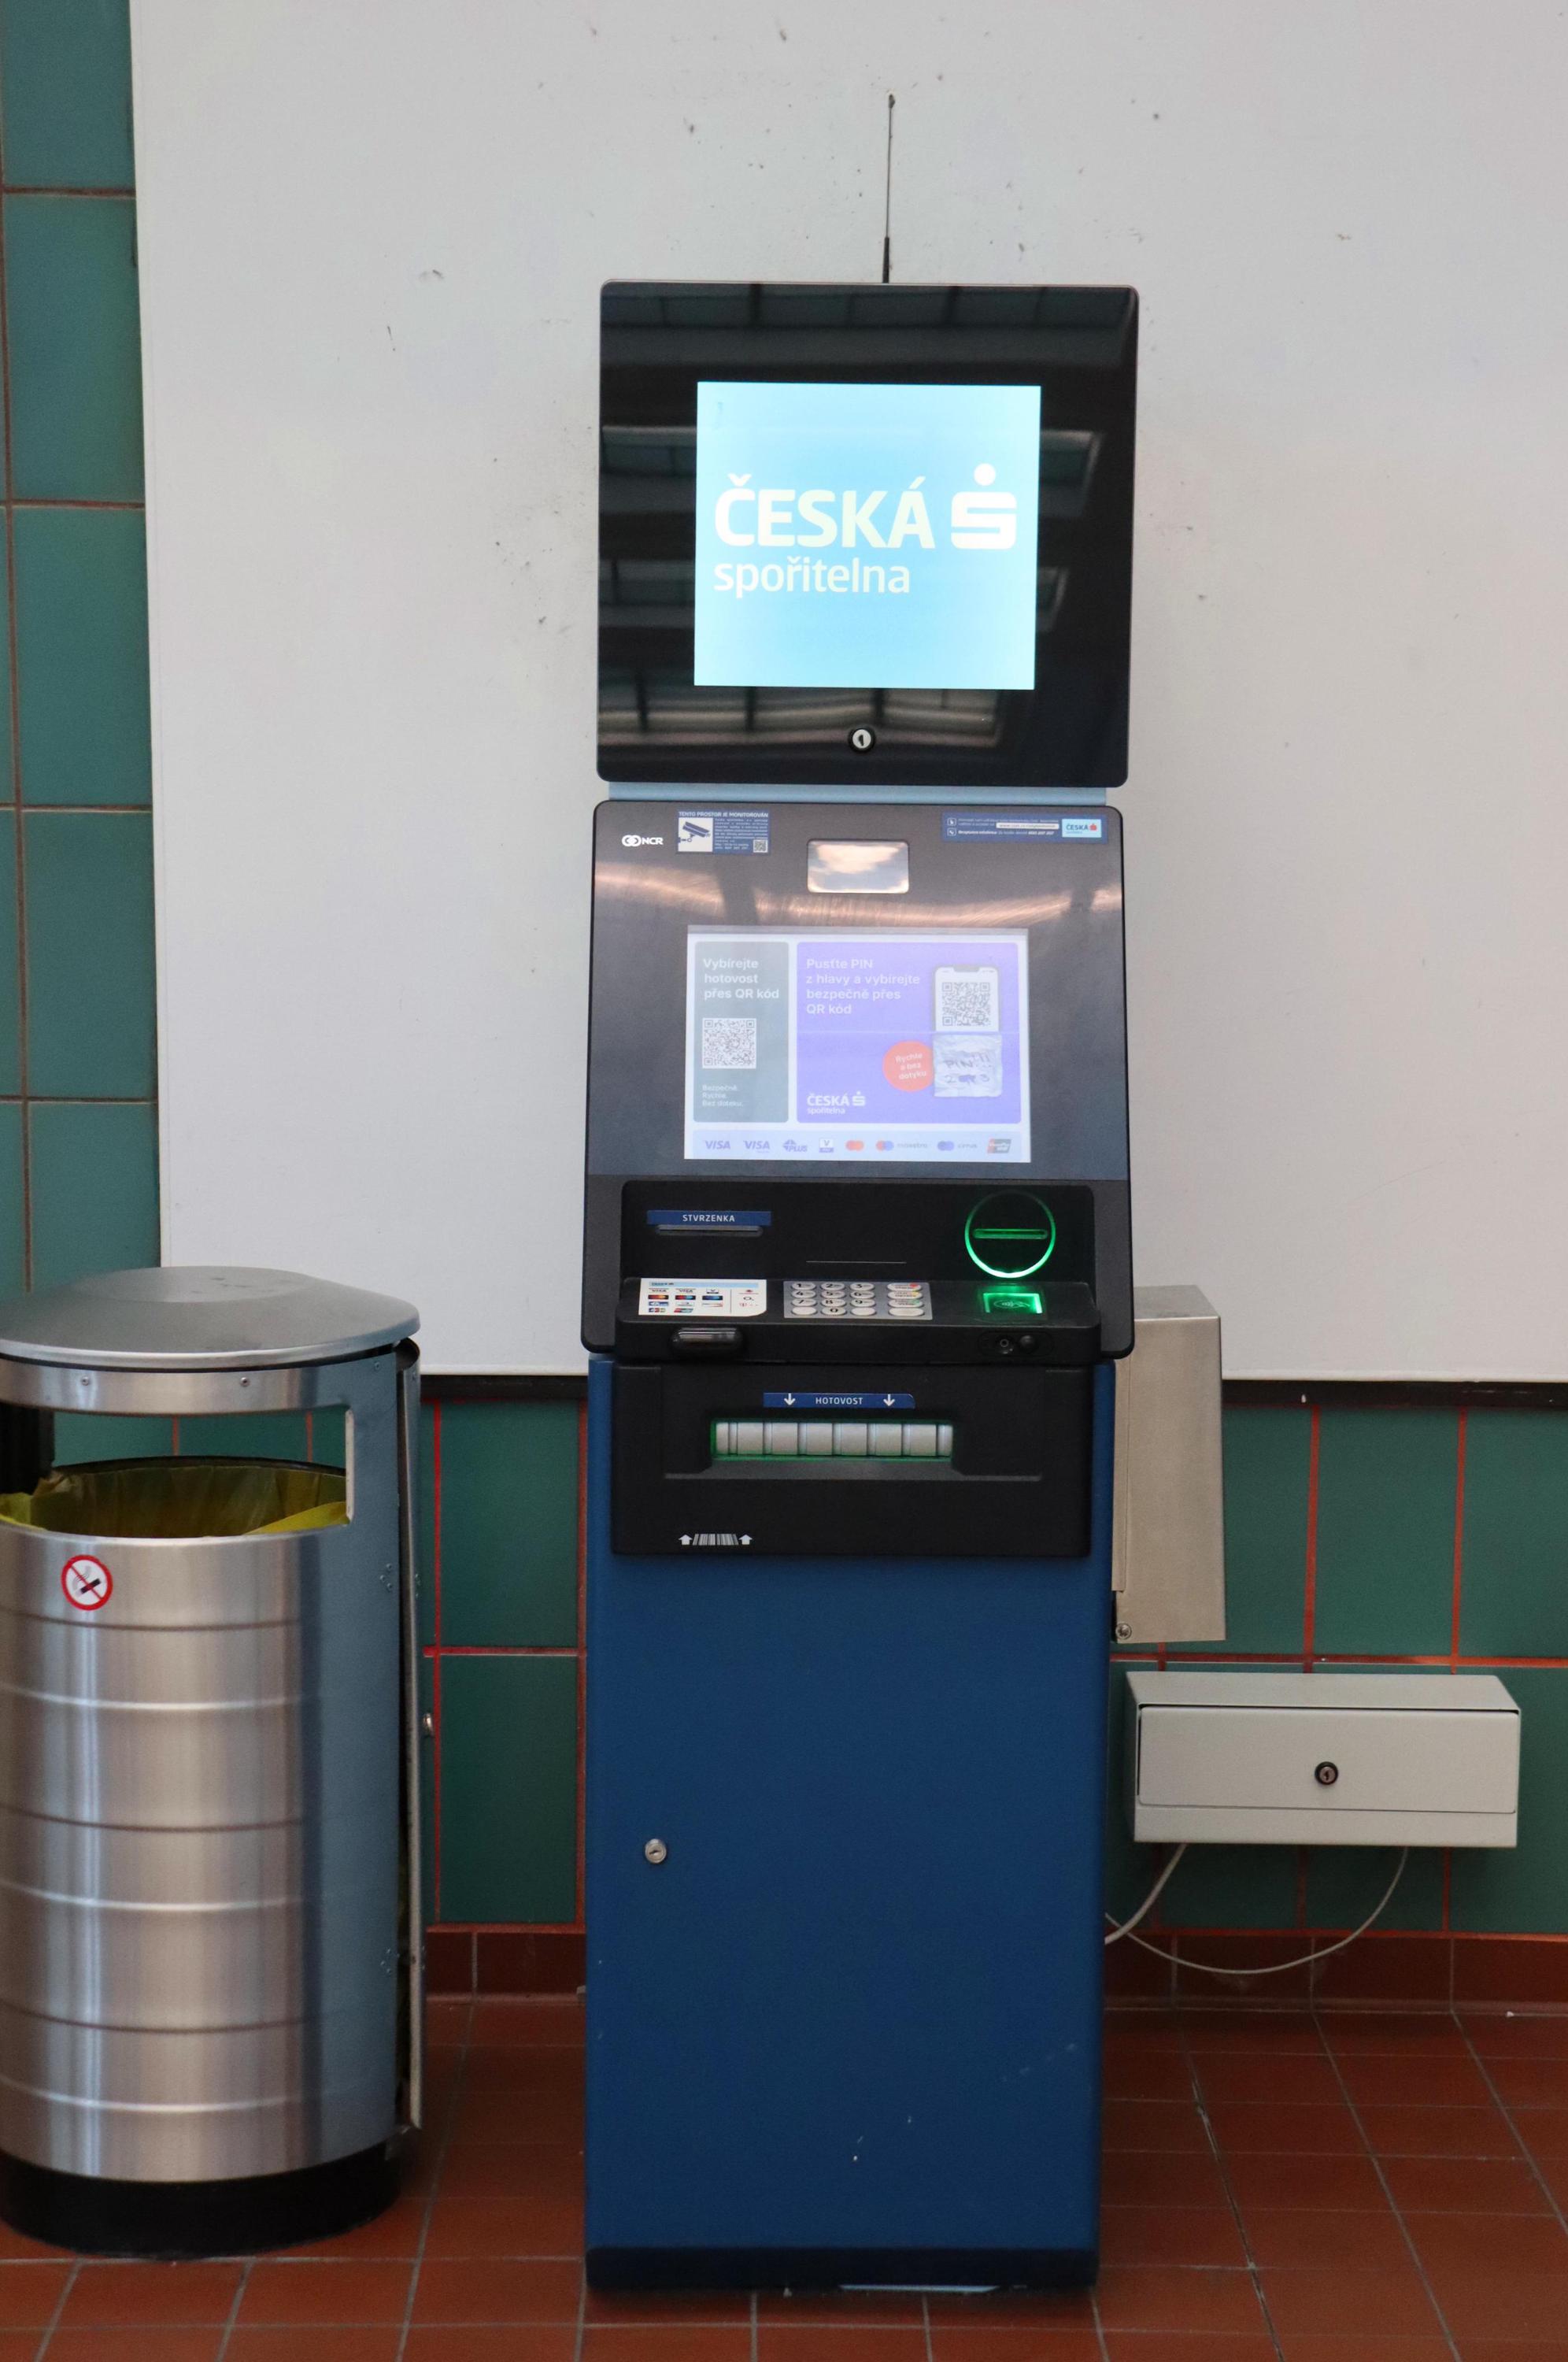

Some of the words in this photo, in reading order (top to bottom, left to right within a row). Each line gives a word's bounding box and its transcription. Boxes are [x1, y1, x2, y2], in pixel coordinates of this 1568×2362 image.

[715, 473, 936, 550] ČESKÁ
[713, 555, 910, 598] spořitelna
[703, 958, 759, 971] Vybírejte
[806, 958, 848, 969] Pusťte
[851, 958, 874, 969] PIN
[704, 973, 759, 984] hotovost
[806, 976, 812, 984] z
[816, 974, 850, 987] hlavy
[854, 976, 861, 984] a
[704, 988, 732, 1001] přes
[735, 988, 753, 999] QR
[756, 988, 779, 999] kód
[806, 989, 870, 1001] bezpečně
[872, 989, 901, 1001] přes
[806, 1004, 826, 1015] QR
[828, 1004, 852, 1015] kód
[898, 1071, 927, 1081] dotyku
[807, 1092, 850, 1106] ČESKÁ
[807, 1106, 845, 1116] spořitelna
[704, 1140, 731, 1150] VISA
[743, 1140, 771, 1150] VISA
[815, 1397, 864, 1405] HOTOVOST
